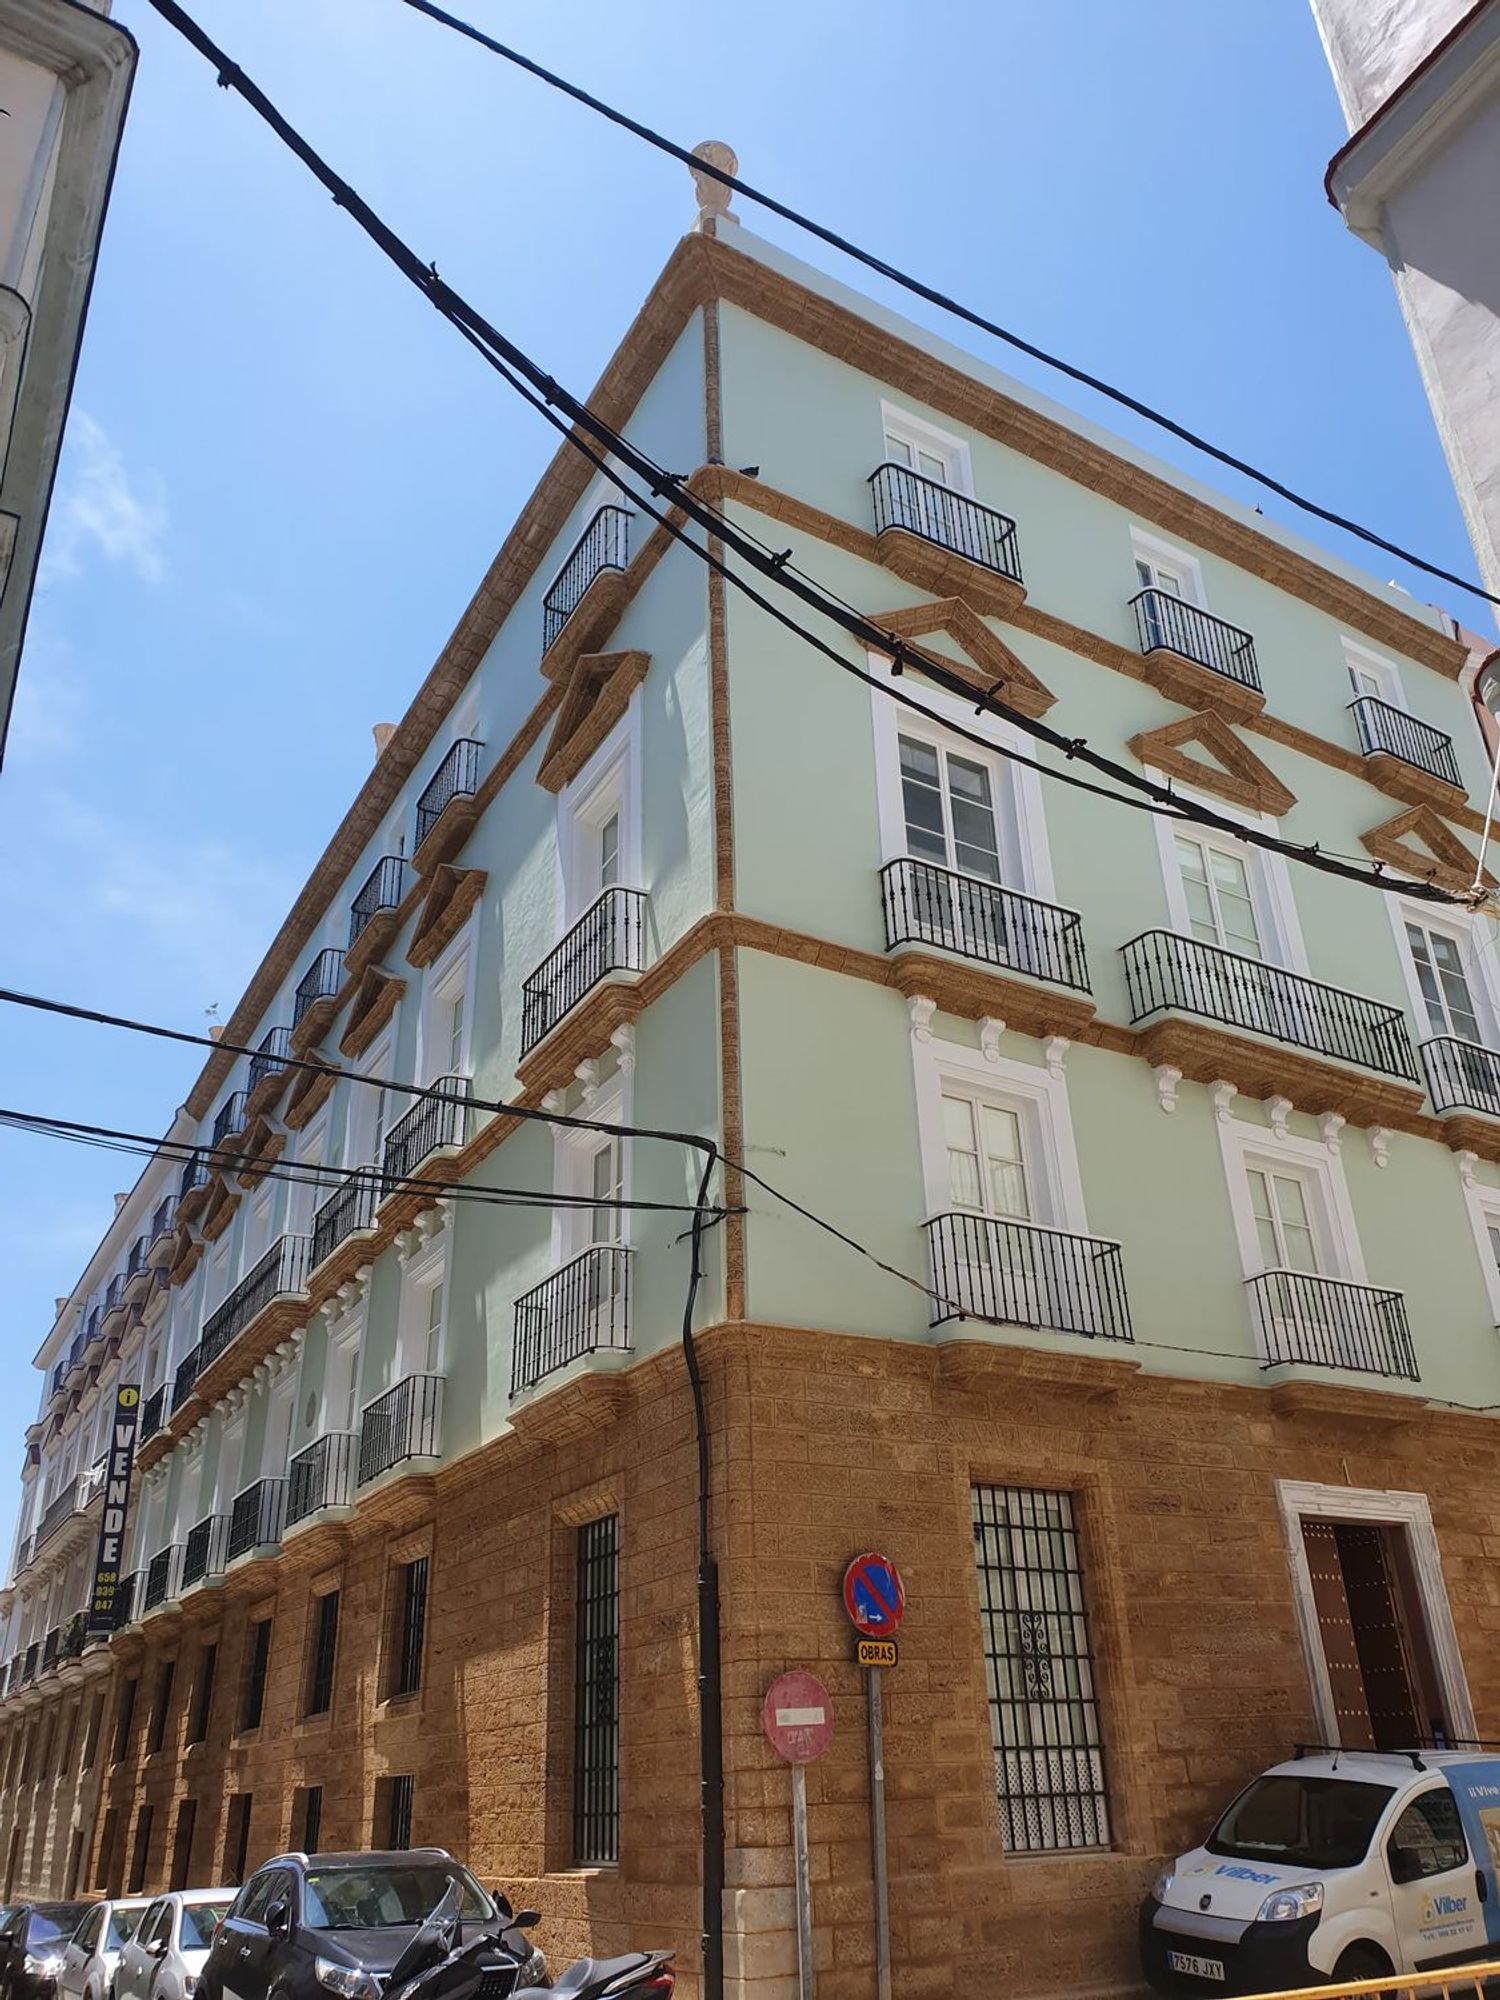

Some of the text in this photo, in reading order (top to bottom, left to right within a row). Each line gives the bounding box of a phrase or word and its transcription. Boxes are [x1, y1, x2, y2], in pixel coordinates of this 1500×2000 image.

[102, 1424, 135, 1563] VENDE
[861, 1645, 894, 1661] OBRAS
[1215, 1865, 1282, 1885] Vilber
[1433, 1895, 1467, 1915] Vilber
[1174, 1955, 1222, 1977] 7576 JXY
